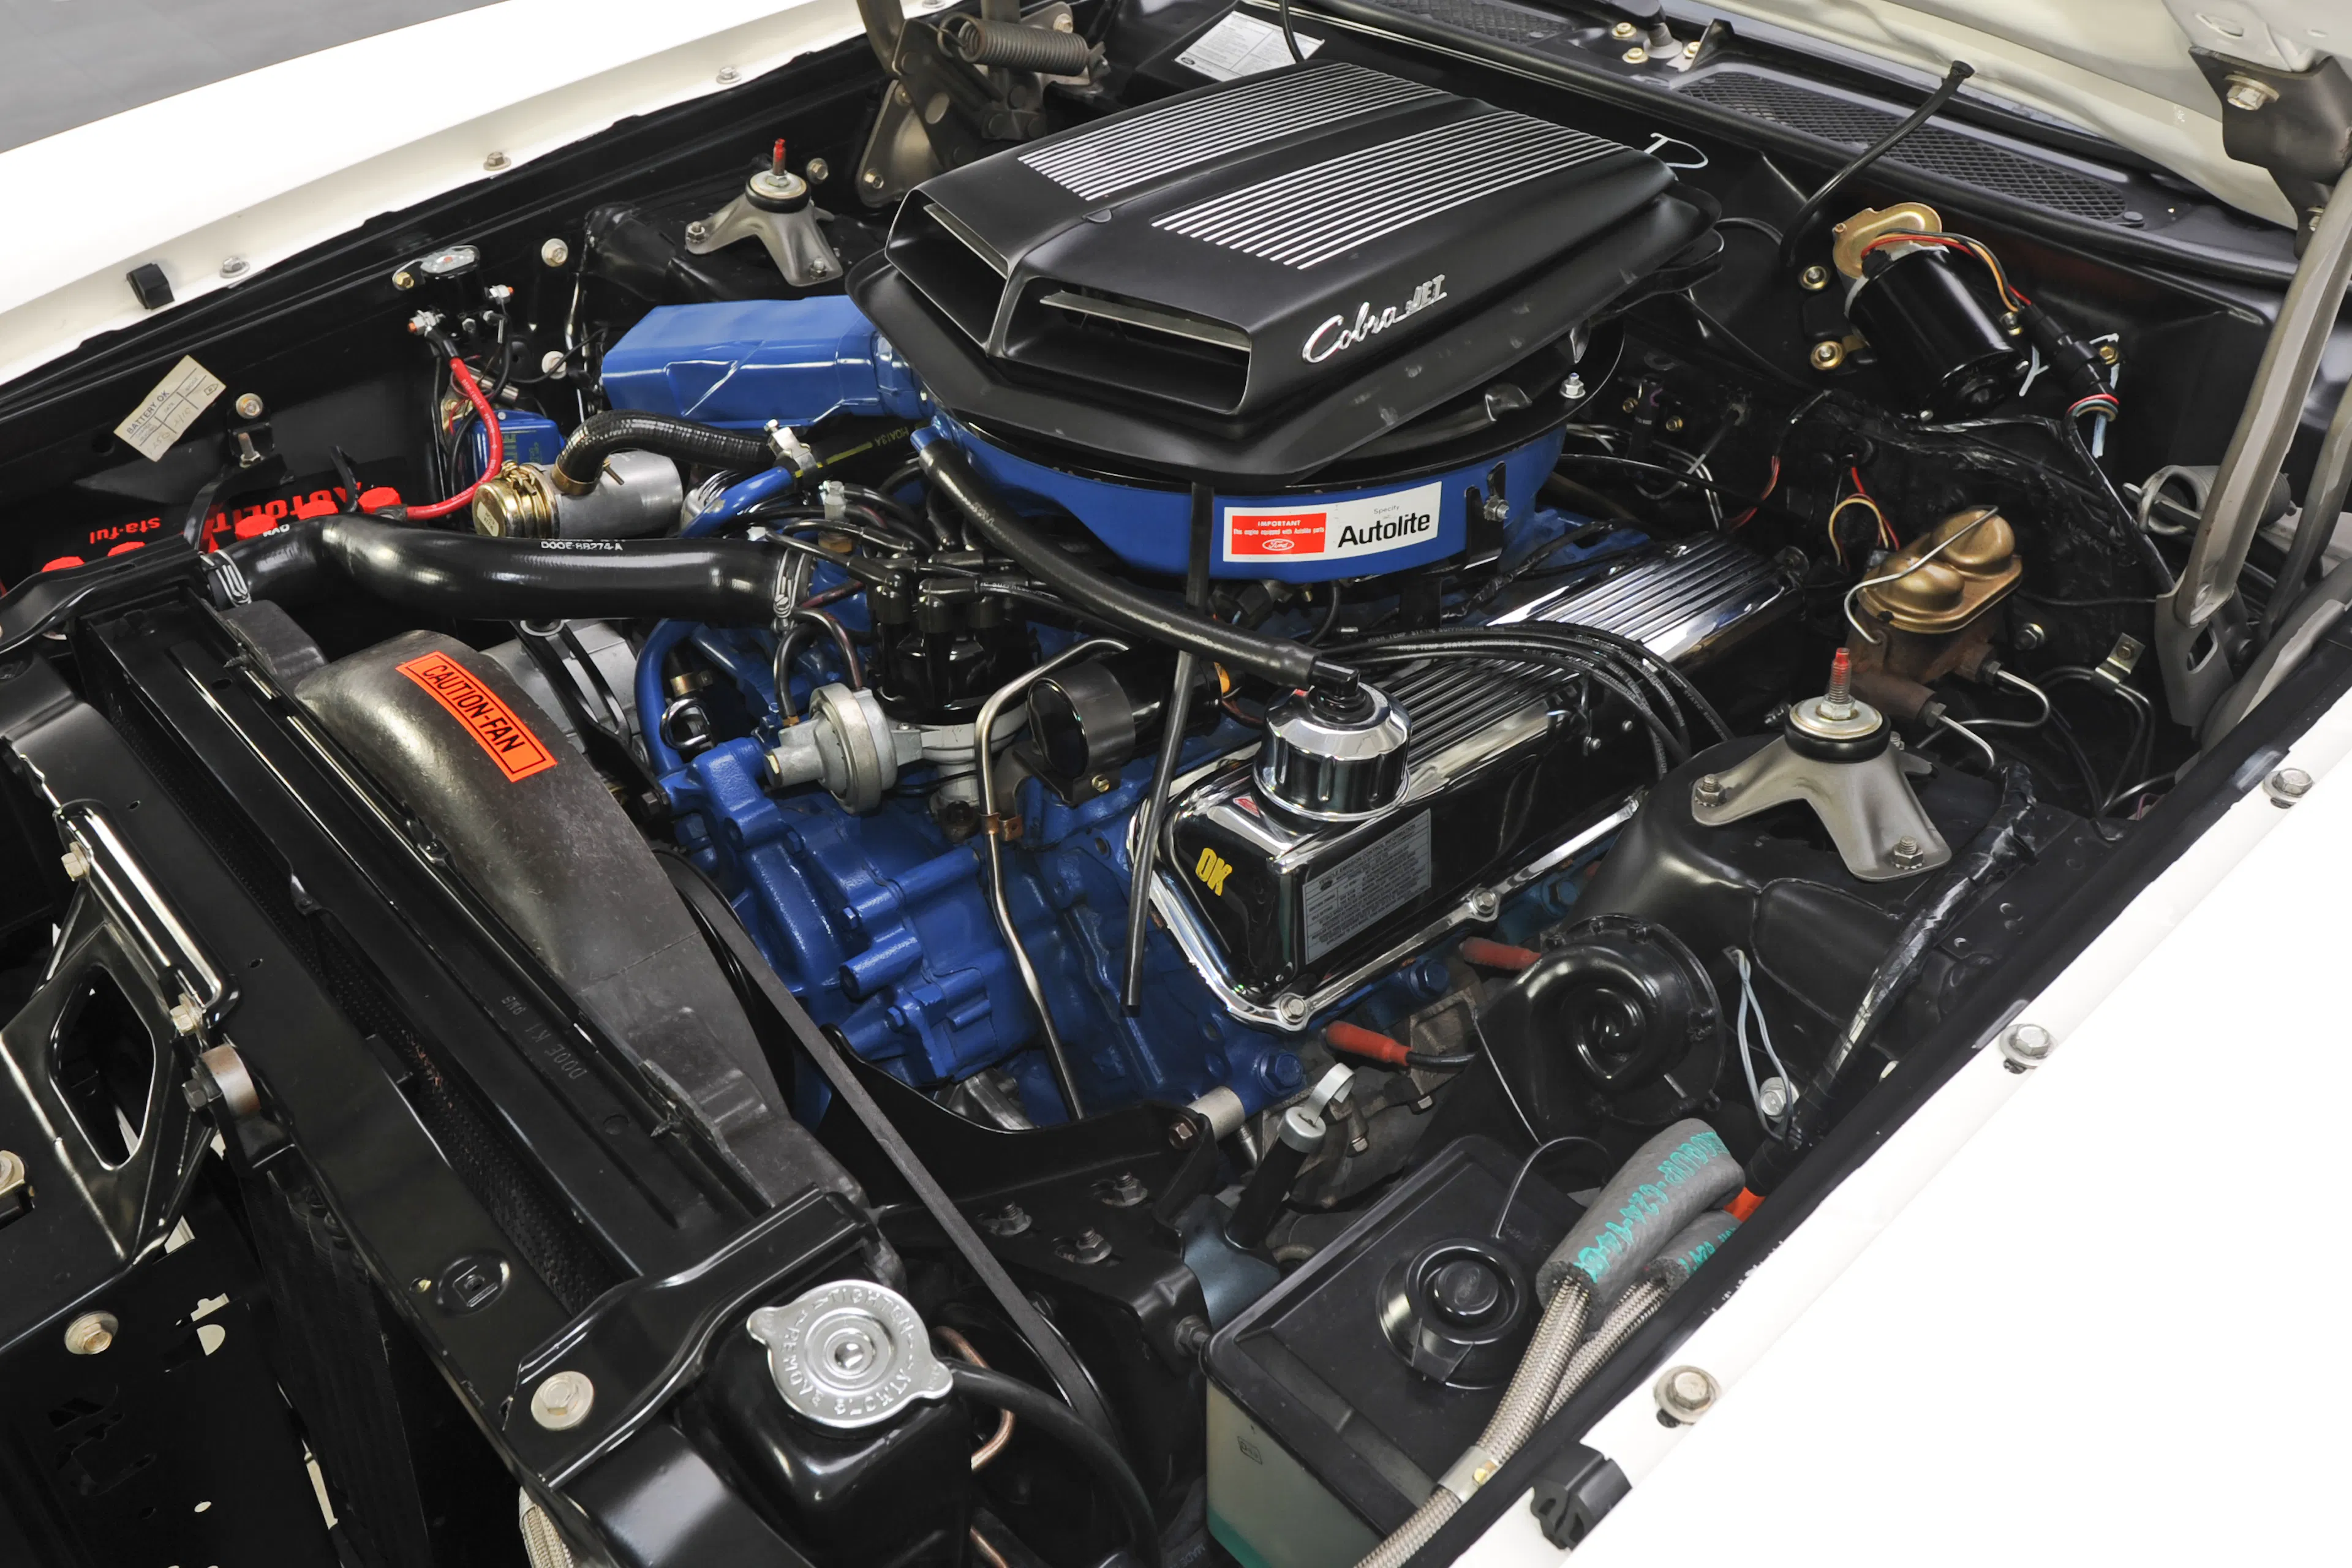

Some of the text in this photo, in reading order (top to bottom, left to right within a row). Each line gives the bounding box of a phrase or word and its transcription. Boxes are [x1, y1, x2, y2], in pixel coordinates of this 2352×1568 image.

[1302, 274, 1446, 363] Cobra JET
[126, 390, 170, 435] BATTERY OK
[1338, 513, 1431, 548] Autolite
[423, 665, 526, 753] CAUTION-FAN
[1195, 847, 1233, 897] OK
[827, 1287, 915, 1335] TIGHTEN
[780, 1326, 825, 1408] REMOVE
